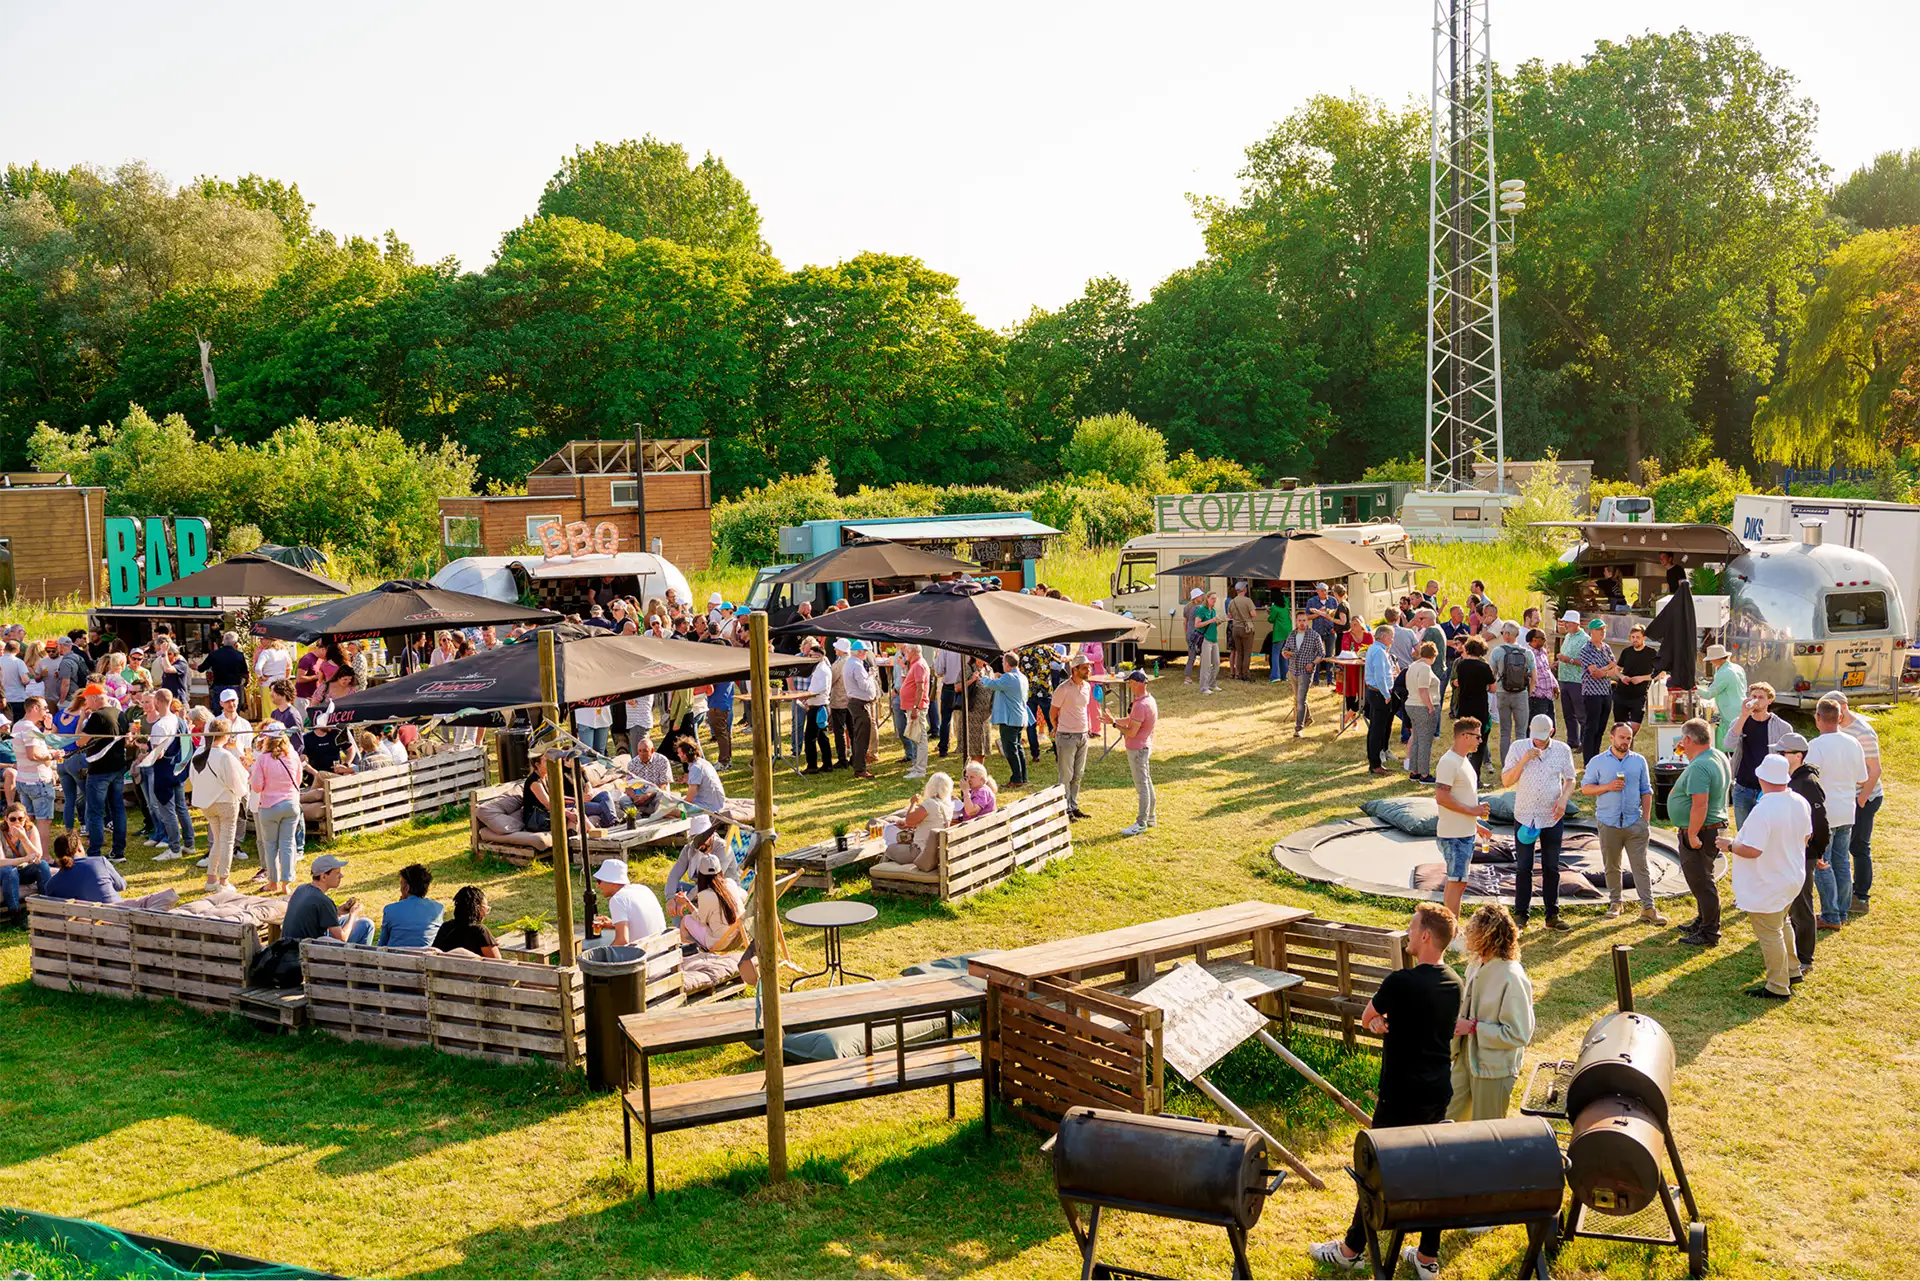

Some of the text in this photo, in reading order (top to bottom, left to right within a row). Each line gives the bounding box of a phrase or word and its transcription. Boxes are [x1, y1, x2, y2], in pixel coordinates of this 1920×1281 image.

[1157, 491, 1317, 532] ECOPIZZA
[536, 521, 619, 558] BBQ
[1743, 516, 1764, 542] DIKS
[104, 515, 214, 608] BAR
[866, 621, 926, 634] Princen
[424, 681, 487, 692] Princen
